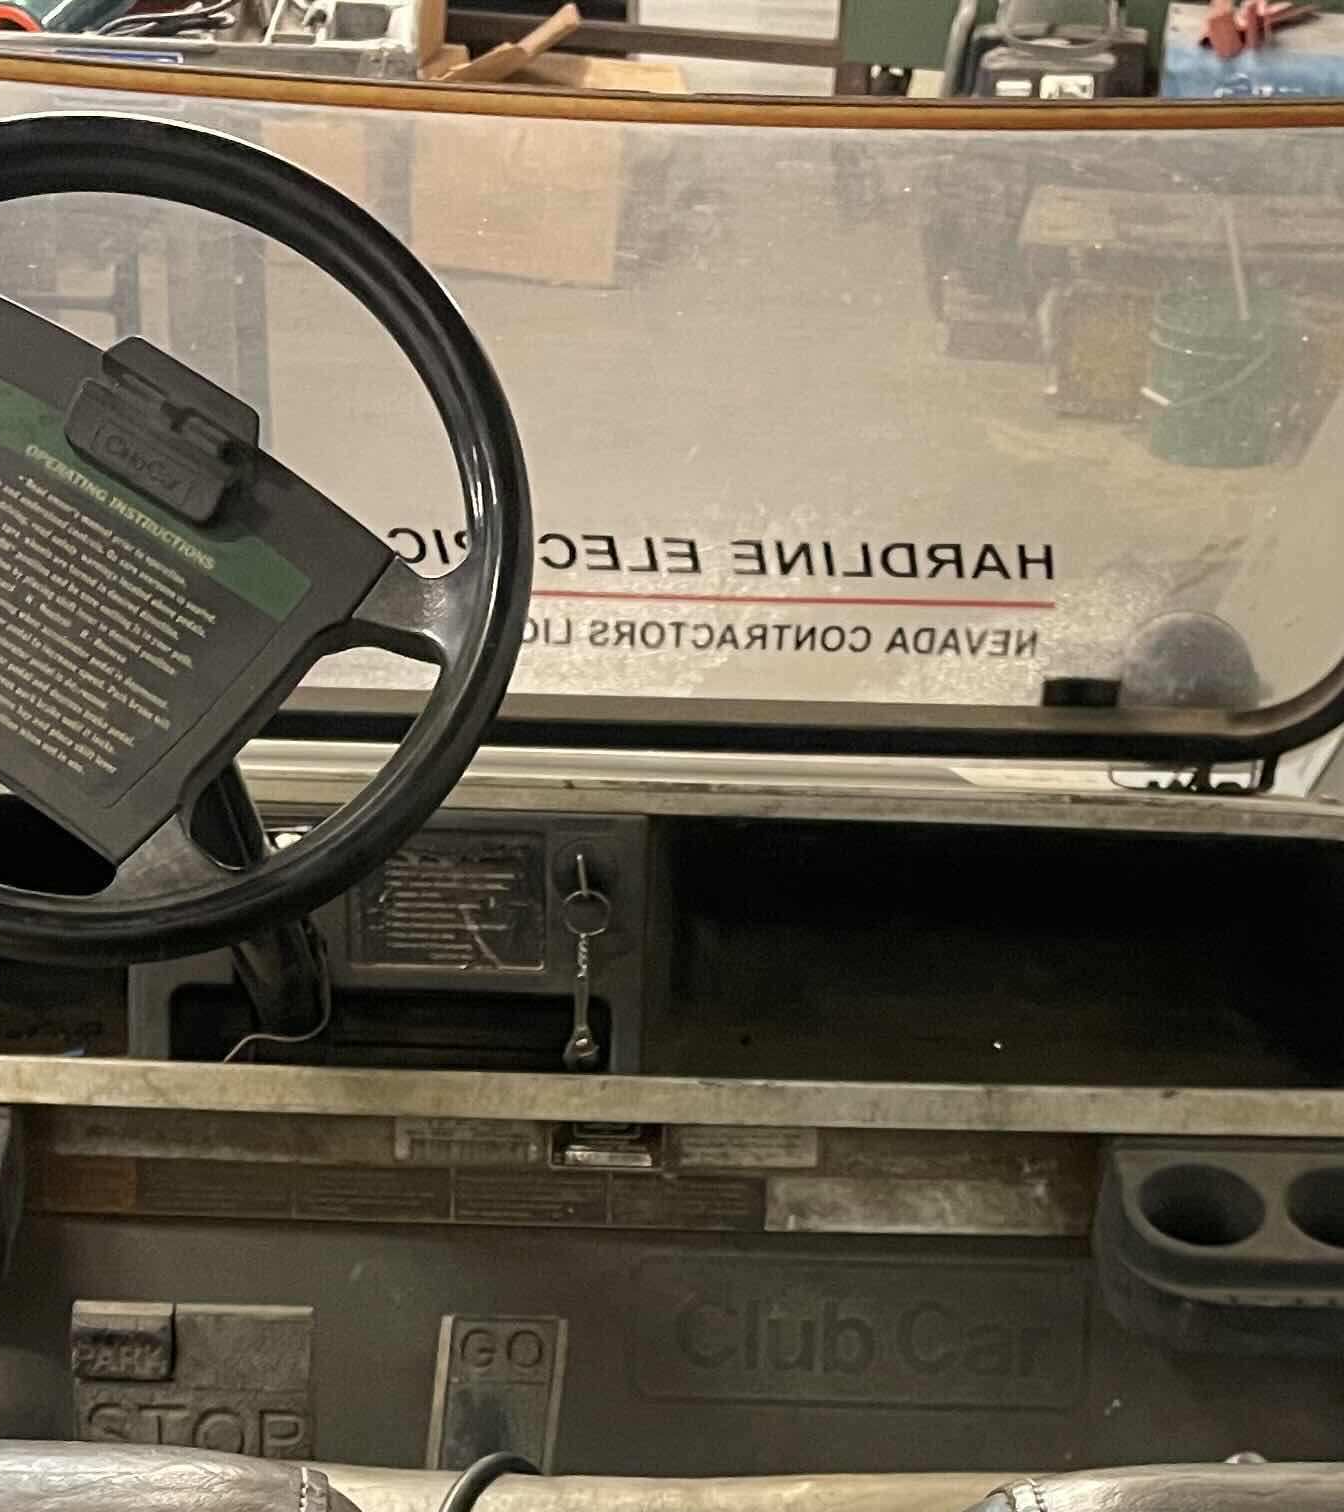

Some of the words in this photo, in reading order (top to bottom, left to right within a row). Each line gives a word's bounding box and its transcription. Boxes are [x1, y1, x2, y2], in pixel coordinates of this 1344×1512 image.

[25, 444, 108, 501] OPERATING
[109, 496, 216, 570] INSTRUCTIONS
[75, 1342, 169, 1376] PARK
[459, 1327, 545, 1369] GO
[674, 1300, 875, 1374] Club
[896, 1301, 1054, 1378] Car
[87, 1401, 306, 1458] STOP
